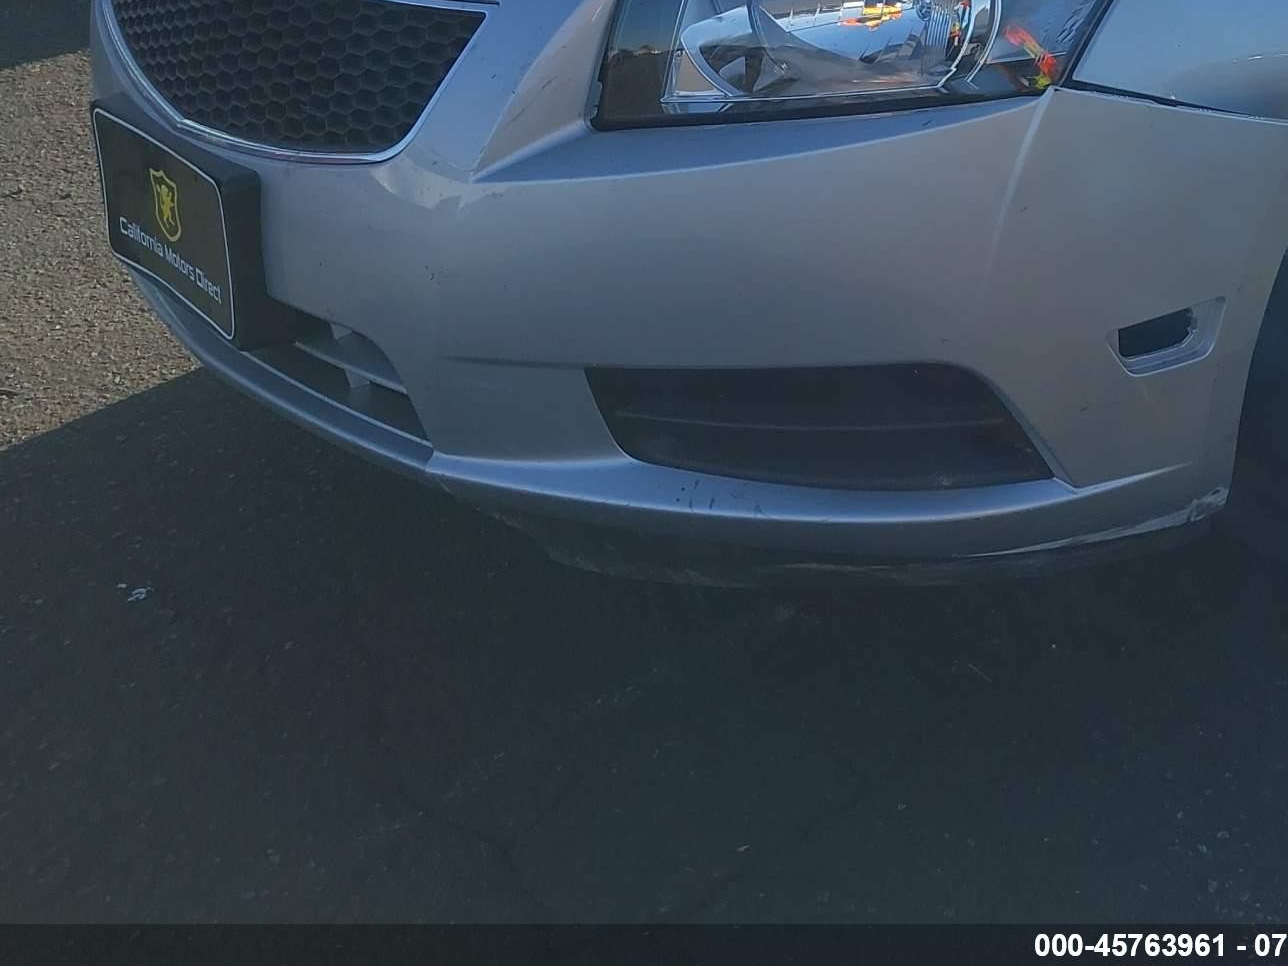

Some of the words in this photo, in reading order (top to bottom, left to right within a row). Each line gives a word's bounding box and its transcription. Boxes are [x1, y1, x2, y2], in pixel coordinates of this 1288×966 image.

[120, 216, 164, 258] California
[164, 244, 195, 283] Motors
[195, 267, 222, 305] Direct
